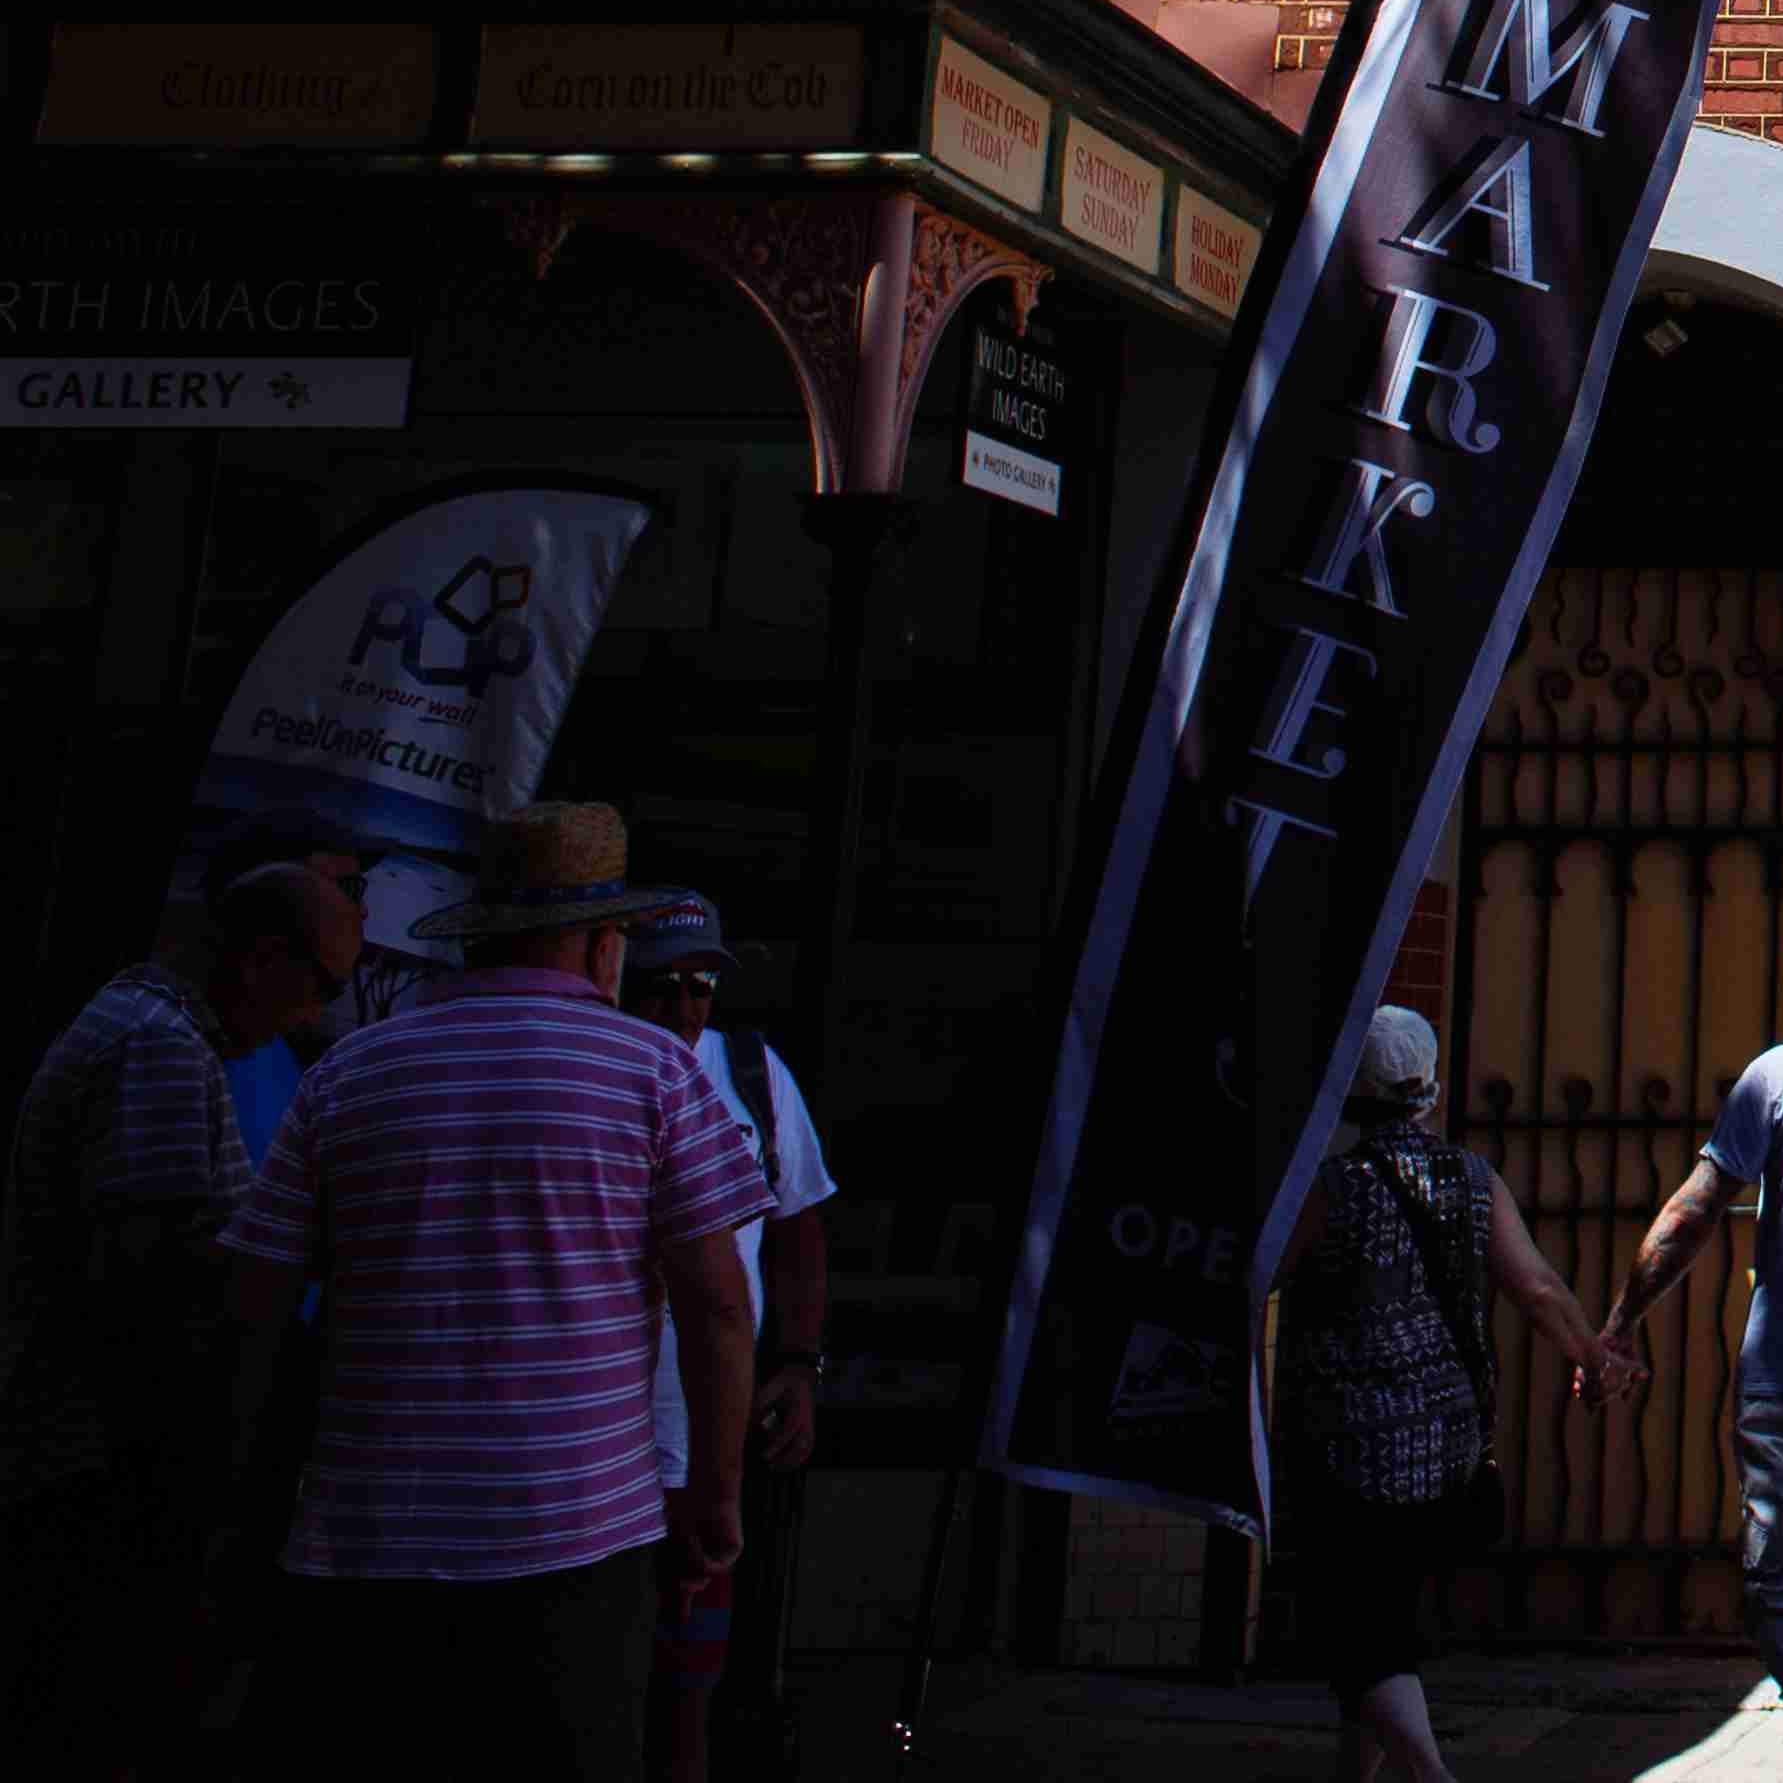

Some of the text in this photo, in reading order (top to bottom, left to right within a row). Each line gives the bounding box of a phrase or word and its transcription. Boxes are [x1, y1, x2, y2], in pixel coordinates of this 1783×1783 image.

[160, 61, 350, 114] Clothing
[515, 62, 826, 113] Corn on the Cob
[941, 68, 1040, 151] MARKET OPEN
[961, 120, 1014, 171] FRIDAY
[1075, 146, 1151, 215] SATURDAY
[1081, 194, 1139, 249] SUNDAY
[1190, 216, 1245, 267] HOLIDAY
[1190, 253, 1240, 305] MONDAY
[138, 280, 384, 333] IMAGES
[18, 370, 244, 410] GALLERY
[976, 328, 1064, 401] WILD EARTH
[992, 387, 1048, 440] IMAGES
